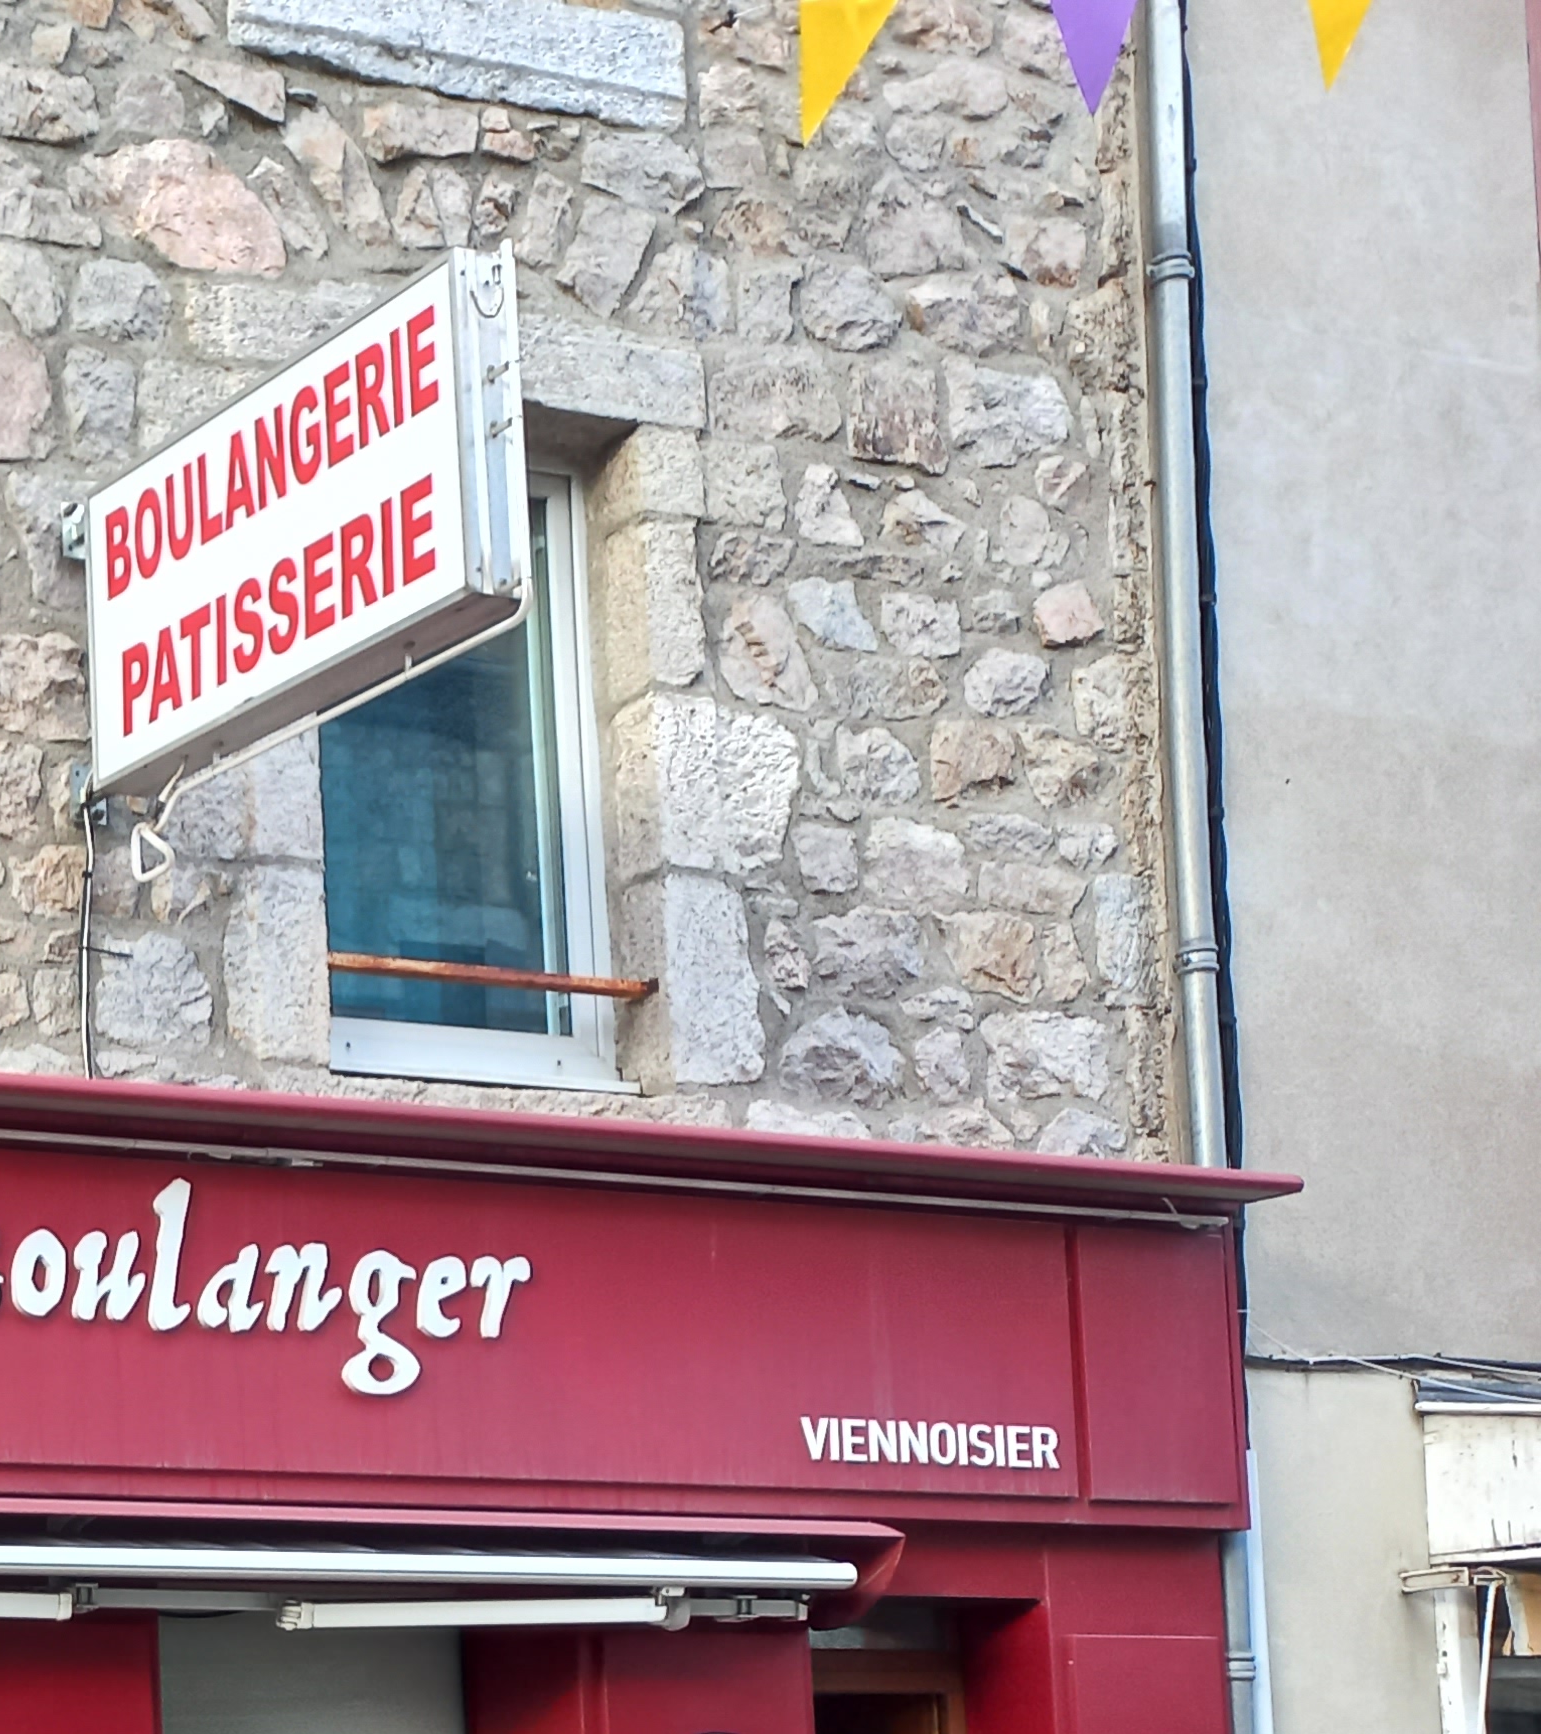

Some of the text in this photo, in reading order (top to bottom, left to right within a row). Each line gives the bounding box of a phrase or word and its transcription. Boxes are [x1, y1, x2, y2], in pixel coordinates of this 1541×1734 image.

[105, 304, 440, 601] BOULANGERIE
[122, 472, 437, 737] PATISSERIE
[800, 1416, 1060, 1469] VIENNOISIER
